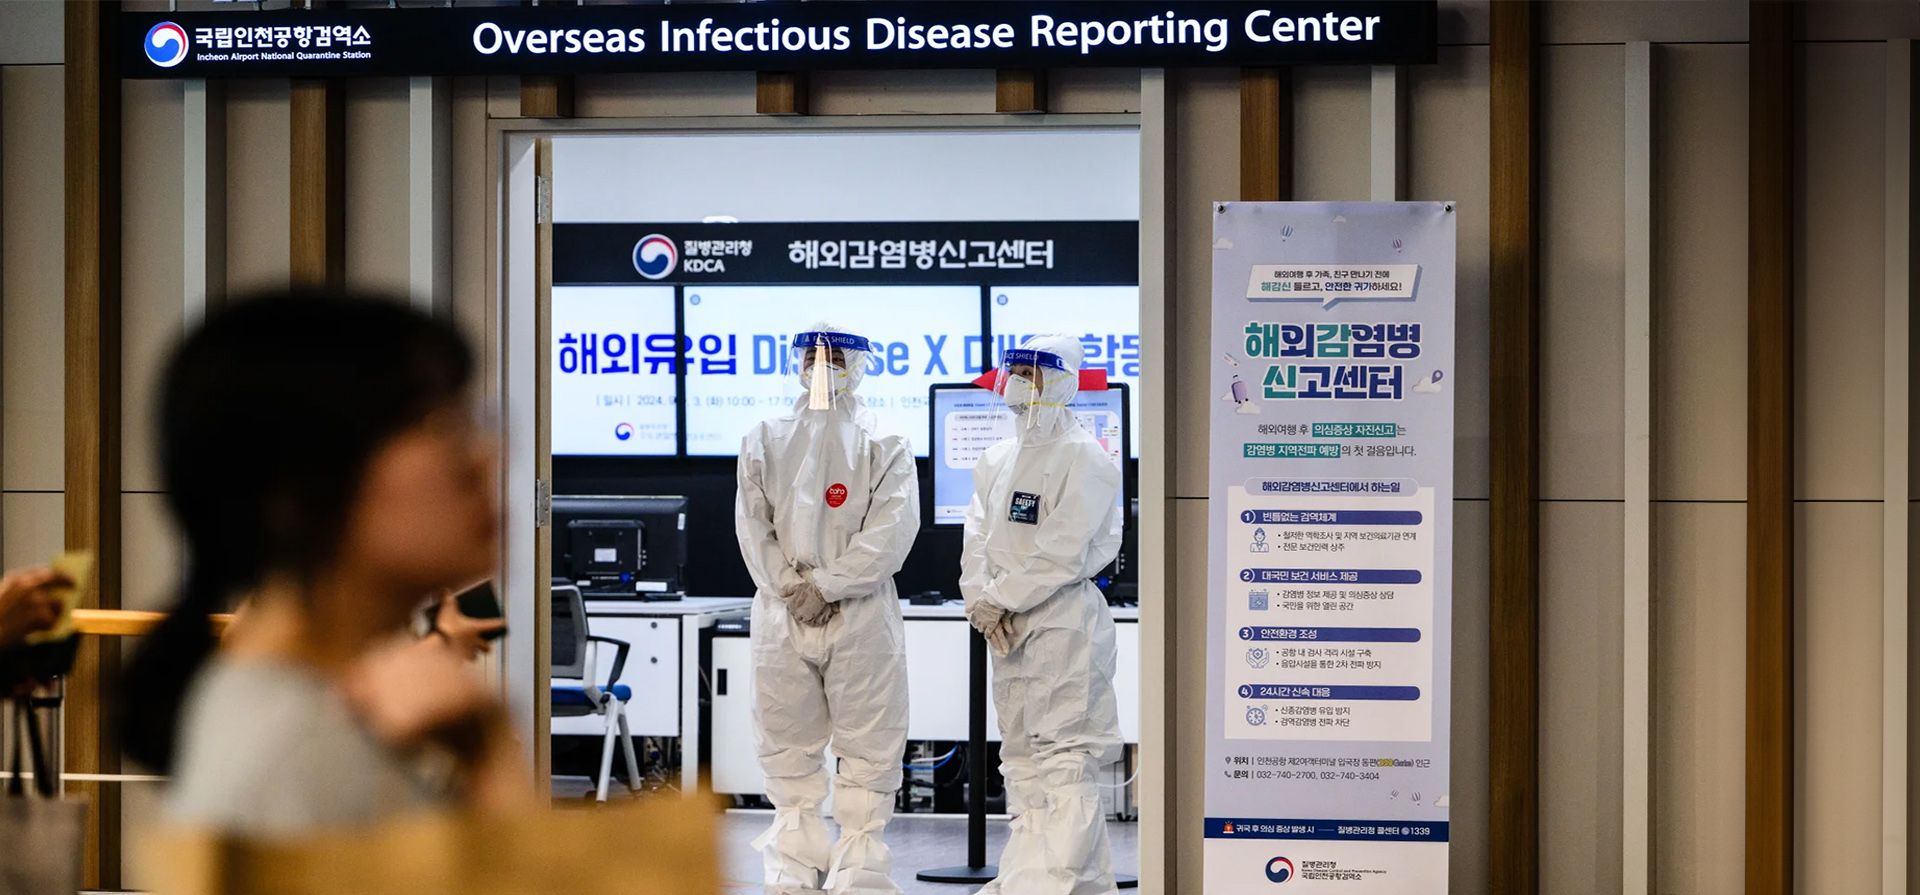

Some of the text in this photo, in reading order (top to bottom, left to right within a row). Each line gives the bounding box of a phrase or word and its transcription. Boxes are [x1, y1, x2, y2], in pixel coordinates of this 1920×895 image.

[195, 25, 371, 48] 국립인천공항검역소
[472, 9, 1380, 55] Overseas Infectious Disease Reporting Center
[197, 51, 371, 62] Incheon Airport National Quarantine Station
[684, 240, 752, 256] 질병관리청
[788, 240, 1053, 269] 해외감염병신고센터
[684, 259, 725, 272] KDCA
[1274, 270, 1389, 280] 해외여행 후 가족, 친구 만나기 전에
[1261, 282, 1402, 292] 해감신 들르고, 안전한 귀가하세요!
[1245, 322, 1420, 358] 해외감염병
[559, 333, 737, 375] 해외유입
[924, 334, 948, 376] X
[1263, 365, 1402, 399] 신고센터
[1258, 424, 1297, 435] 해외여행
[1300, 424, 1309, 435] 후
[1314, 424, 1352, 435] 의심증상
[1247, 445, 1275, 456] 감염병
[1278, 445, 1316, 456] 지역전파
[1354, 445, 1363, 456] 첫
[1367, 445, 1416, 456] 걸음입니다.
[1262, 482, 1400, 492] 해외감염병신고센터에서 하는일
[1245, 512, 1337, 522] 1 빈틈없는 검역체계
[1335, 531, 1343, 541] 및
[1344, 531, 1357, 541] 지역
[1402, 531, 1416, 541] 연계
[1283, 543, 1297, 551] 전문
[1331, 543, 1344, 551] 상주
[1243, 572, 1358, 581] 2 대국민 보건 서비스 제공
[1282, 590, 1304, 599] 감염병
[1307, 590, 1320, 599] 정보
[1322, 590, 1337, 599] 제공
[1339, 590, 1346, 599] 및
[1379, 590, 1394, 599] 상담
[1306, 602, 1320, 611] 위한
[1322, 602, 1337, 611] 열린
[1339, 602, 1353, 611] 공간
[1243, 629, 1317, 639] 3 안전환경 조성
[1281, 649, 1296, 657] 공항
[1308, 649, 1322, 657] 검사
[1325, 649, 1338, 657] 격리
[1341, 649, 1355, 657] 시설
[1319, 660, 1334, 669] 통한
[1336, 660, 1348, 669] 2차
[1350, 660, 1365, 669] 전파
[1367, 660, 1381, 669] 방지
[1242, 687, 1330, 697] 4 24시간 신속 대응
[1281, 706, 1350, 715] 신종감염병 유입 방지
[1281, 717, 1350, 727] 검역감염병 전파 차단
[1234, 757, 1249, 766] 위치
[1257, 757, 1286, 766] 인천공항
[1288, 757, 1335, 766] 제2여객터미널
[1338, 757, 1360, 766] 입국장
[1416, 759, 1430, 768] 인근
[1234, 771, 1379, 780] 문의 032-740-2700, 032-740-3404
[1237, 825, 1250, 833] 귀국
[1252, 825, 1259, 833] 후
[1260, 825, 1274, 833] 의심
[1307, 825, 1314, 834] 시
[1338, 826, 1375, 835] 질병관리청
